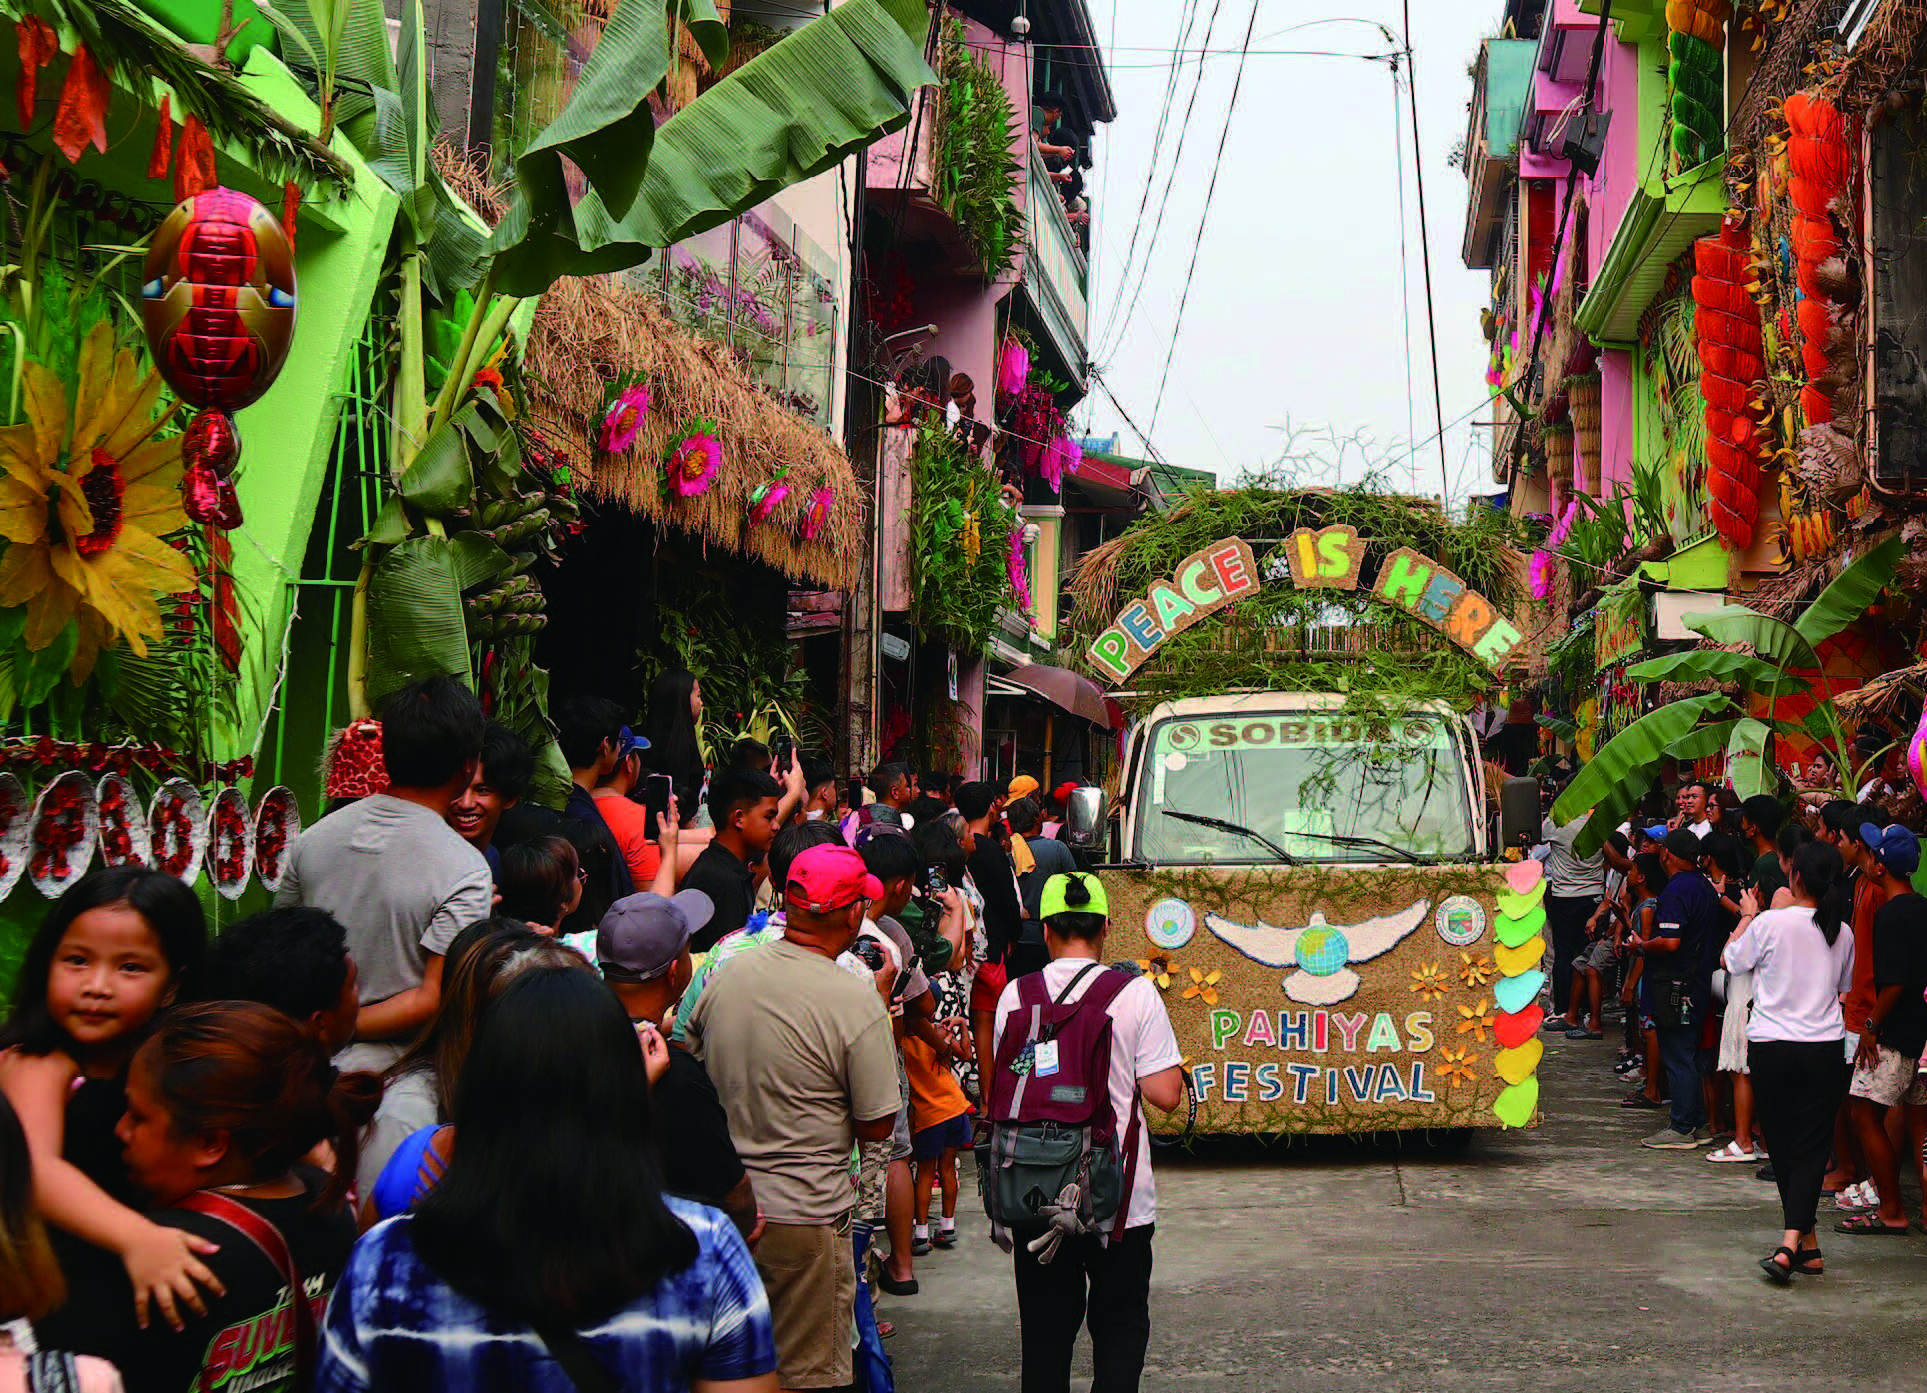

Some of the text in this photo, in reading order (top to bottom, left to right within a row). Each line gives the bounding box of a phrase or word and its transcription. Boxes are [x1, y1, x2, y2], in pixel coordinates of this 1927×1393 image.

[1090, 532, 1523, 677] PEACE IS HERE
[1210, 1009, 1435, 1052] PAHIYAS
[1188, 1087, 1196, 1122] SONY
[1191, 1061, 1436, 1105] FESTIVAL
